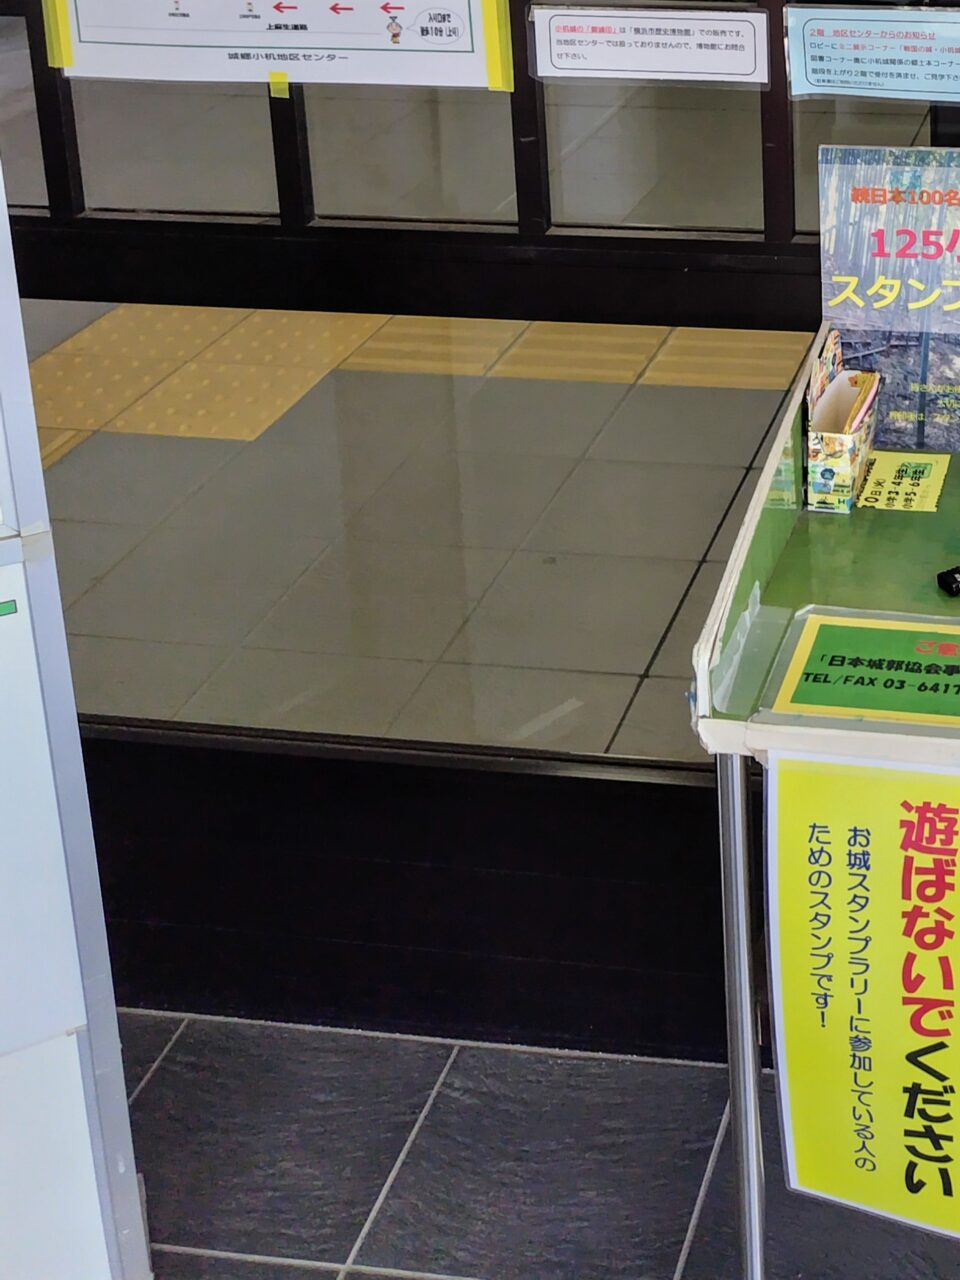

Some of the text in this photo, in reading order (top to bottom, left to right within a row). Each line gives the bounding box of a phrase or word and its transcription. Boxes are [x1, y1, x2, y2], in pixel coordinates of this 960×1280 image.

[807, 822, 833, 1029] ためのスタンプです!
[845, 826, 877, 1173] お城スタンプラリーに参加している人の
[899, 799, 960, 1198] 遊ばないでください
